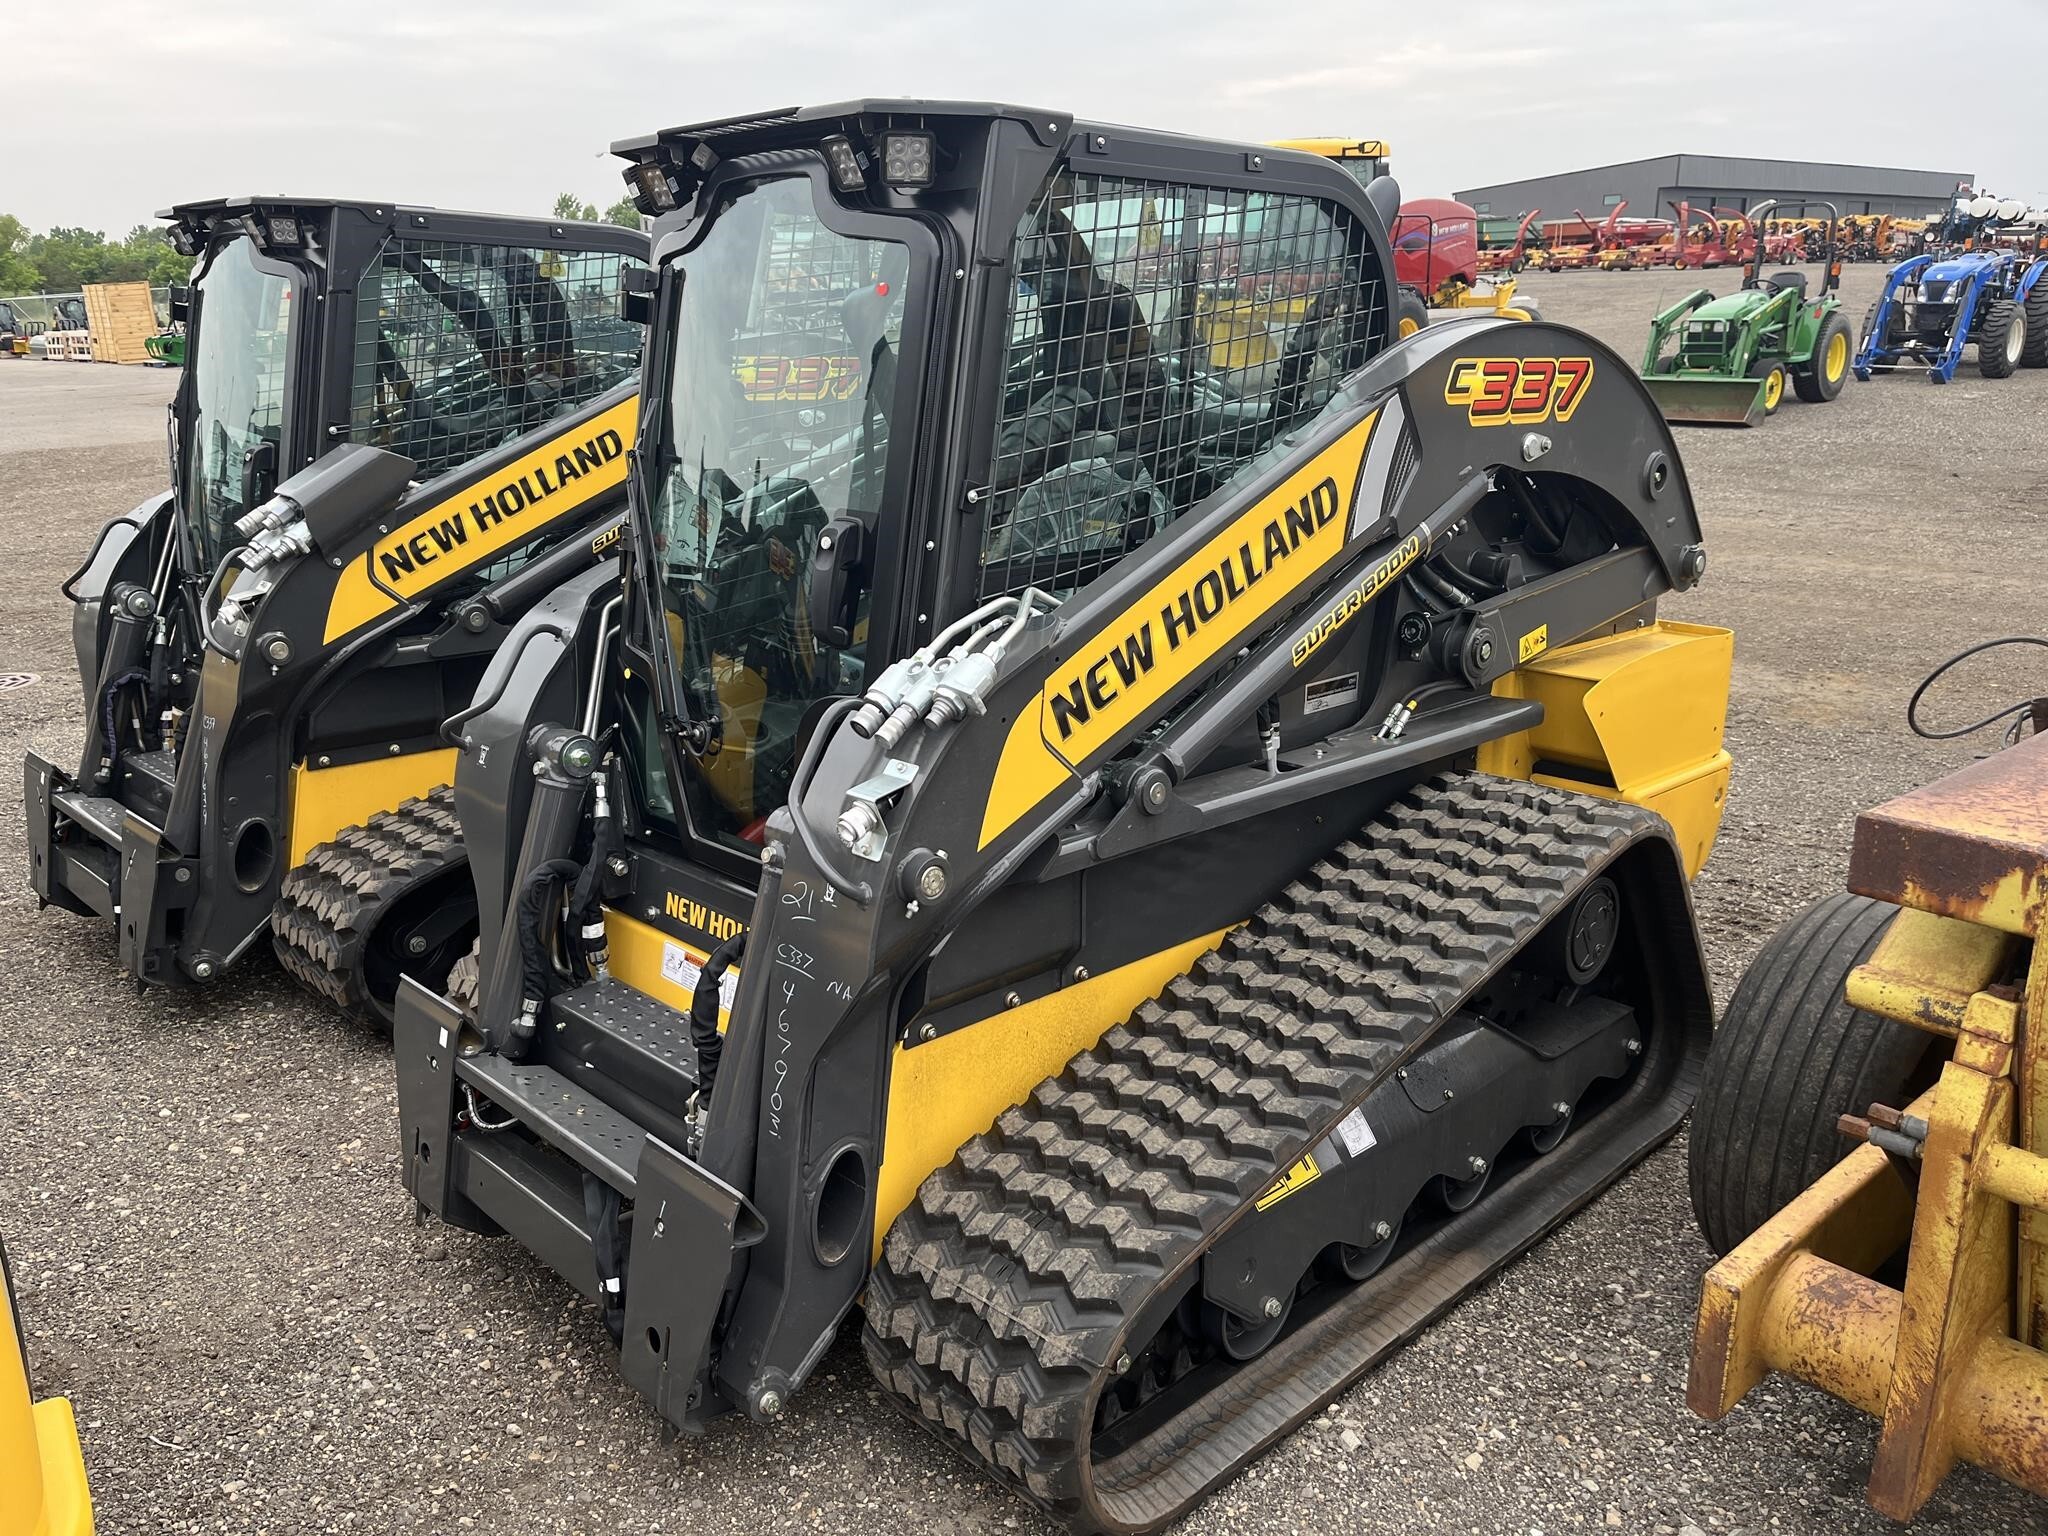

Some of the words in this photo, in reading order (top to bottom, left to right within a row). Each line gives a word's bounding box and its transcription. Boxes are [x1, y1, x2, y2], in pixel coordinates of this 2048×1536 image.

[1445, 358, 1594, 426] C337
[379, 511, 469, 583] NEW
[469, 429, 623, 533] HOLLAND
[1049, 620, 1156, 742] NEW
[1160, 476, 1339, 652] HOLLAND
[1292, 590, 1362, 668] SUPER
[1361, 535, 1419, 602] BOOM
[665, 891, 707, 931] NEW
[781, 881, 814, 915] 21
[777, 943, 814, 969] C337
[826, 981, 854, 1001] NA
